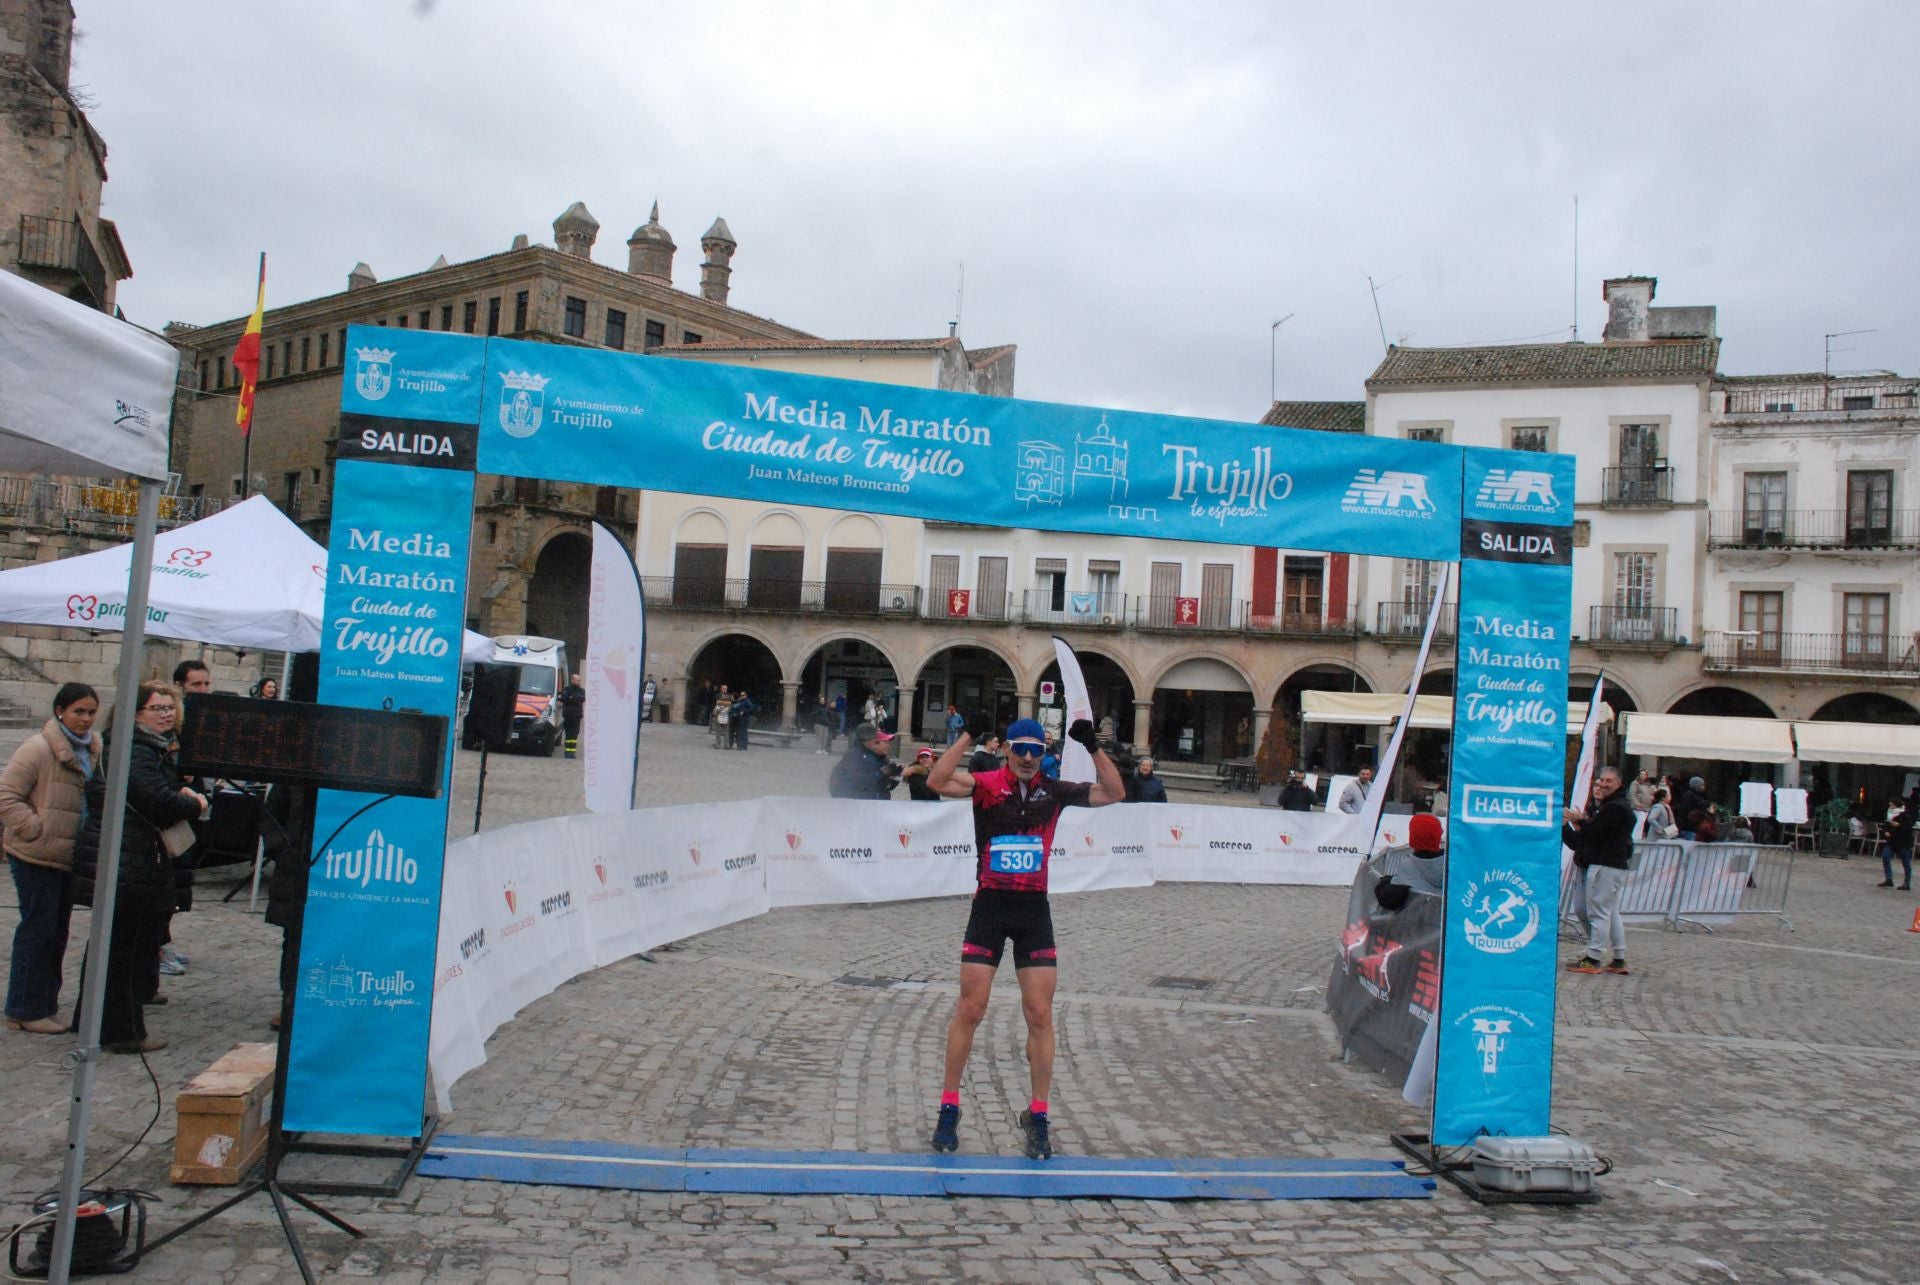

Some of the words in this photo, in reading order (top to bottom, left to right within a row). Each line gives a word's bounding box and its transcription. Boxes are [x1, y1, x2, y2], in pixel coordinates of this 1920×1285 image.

[397, 378, 445, 394] Trujillo
[553, 397, 627, 414] Ayuntamiento
[630, 406, 645, 415] de
[552, 410, 612, 430] Trujillo
[742, 392, 847, 431] Media
[857, 406, 991, 447] Maratón
[361, 429, 454, 456] SALIDA
[702, 421, 810, 459] Ciudad
[816, 438, 854, 464] de
[862, 439, 965, 482] Trujillo
[748, 464, 782, 480] Juan
[786, 468, 838, 486] Mateos
[843, 475, 910, 493] Broncano
[1162, 443, 1293, 511] Trujillo
[1190, 498, 1206, 517] te
[1341, 505, 1433, 520] www.musicrun.es
[1475, 500, 1556, 514] www.musicrun.es
[348, 528, 452, 559] Media
[1480, 531, 1555, 555] SALIDA
[338, 564, 456, 593] Maratón
[351, 596, 413, 618] Ciudad
[414, 604, 438, 619] de
[1474, 616, 1555, 641] Media
[334, 617, 449, 665] Trujillo
[1467, 647, 1561, 671] Maratón
[336, 666, 358, 677] Juan
[360, 669, 395, 680] Mateos
[398, 672, 444, 683] Broncano
[1477, 674, 1524, 692] Ciudad
[1526, 679, 1545, 693] de
[1465, 692, 1556, 731] Trujillo
[1474, 797, 1540, 816] HABLA
[326, 828, 418, 889] trujillo
[1001, 852, 1034, 870] 530
[1461, 880, 1478, 908] Club
[1484, 868, 1533, 895] Atletismo
[356, 970, 415, 996] Trujillo
